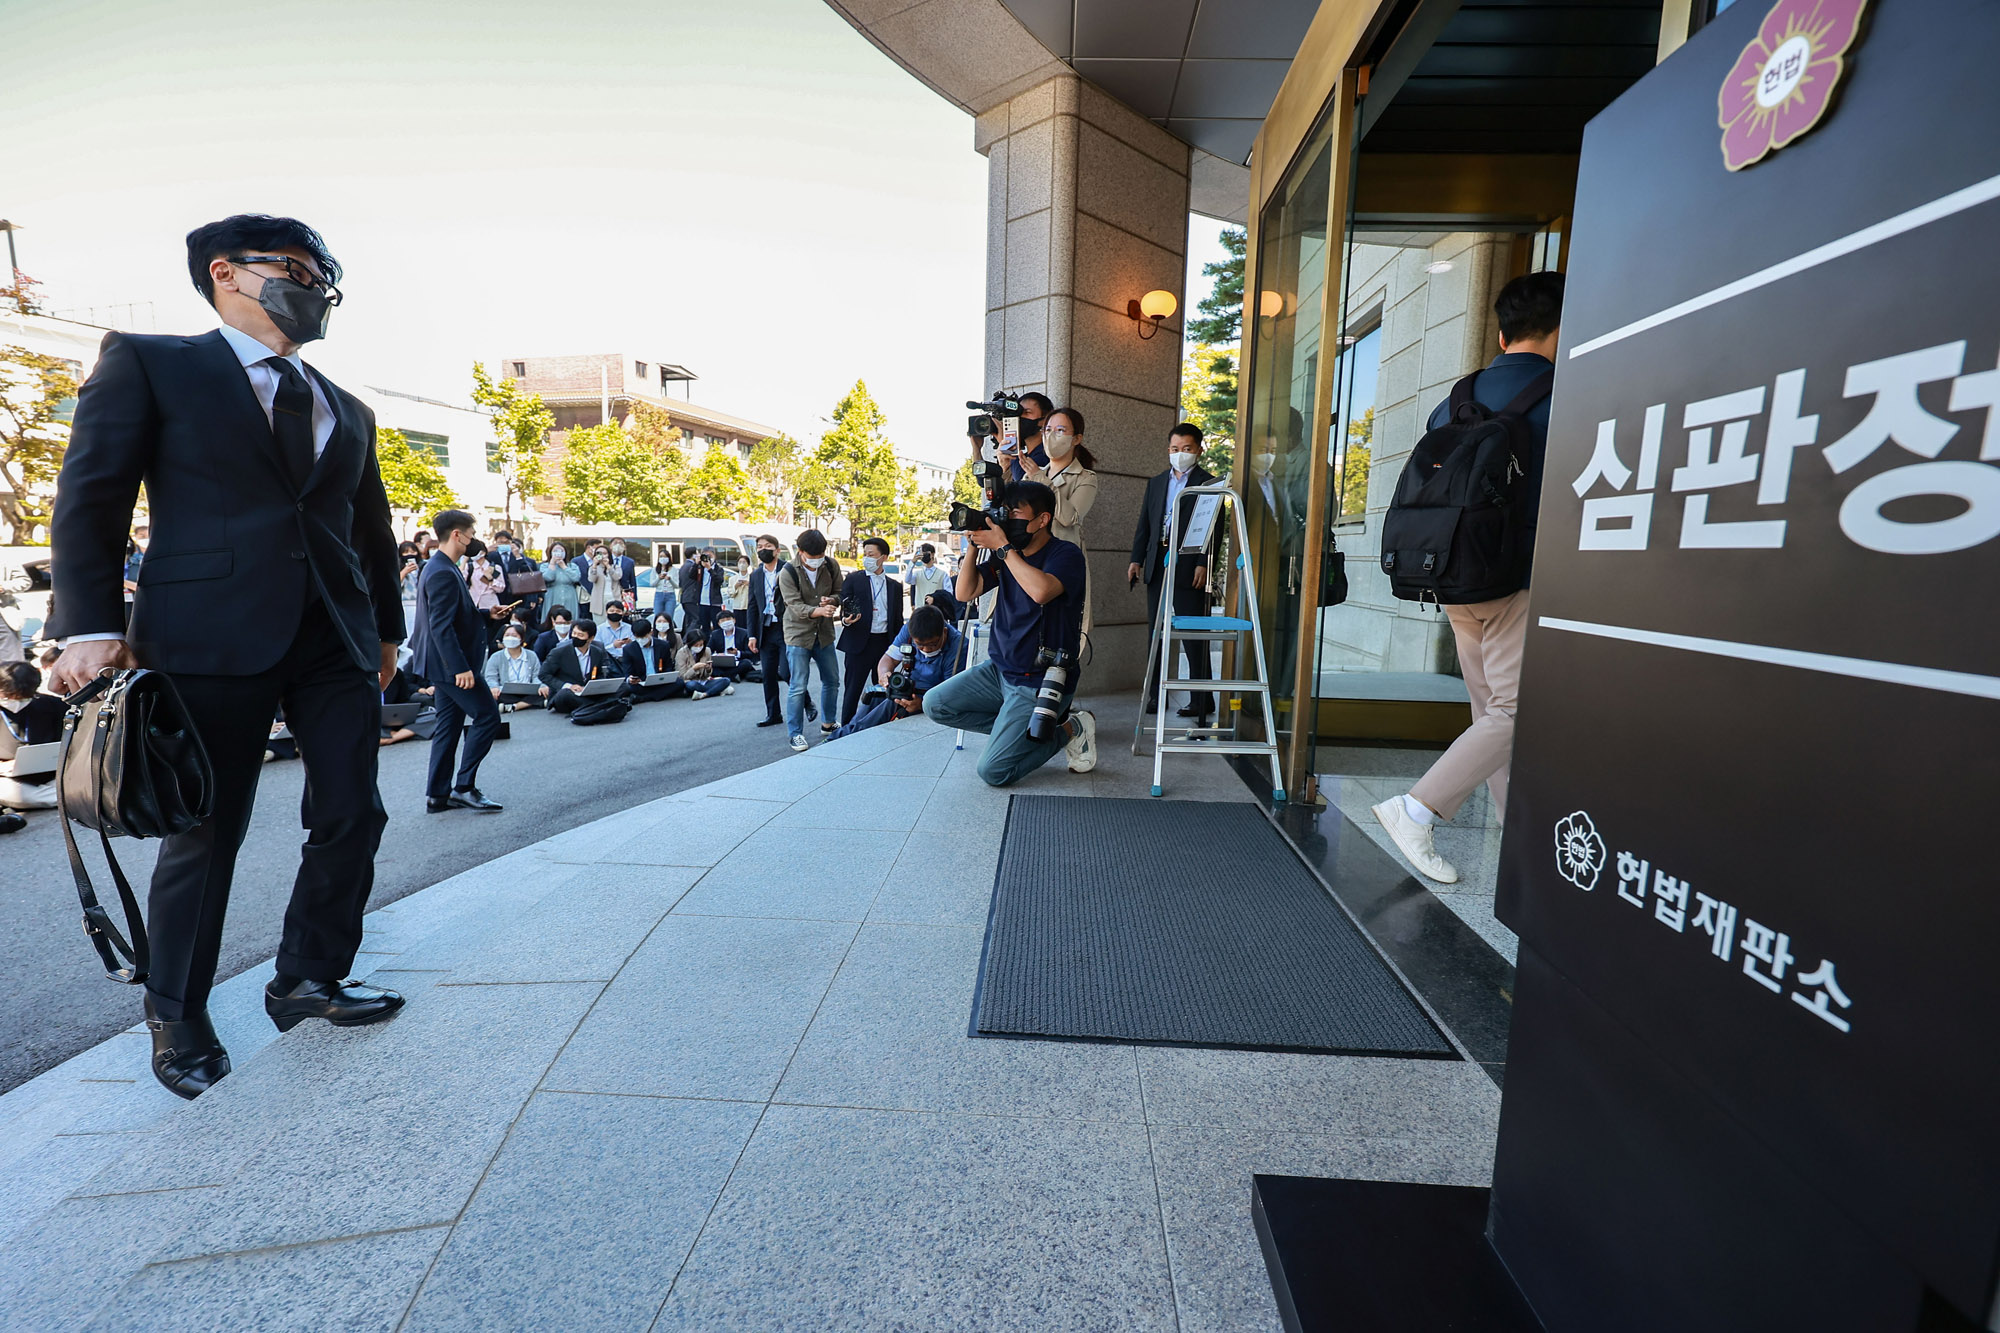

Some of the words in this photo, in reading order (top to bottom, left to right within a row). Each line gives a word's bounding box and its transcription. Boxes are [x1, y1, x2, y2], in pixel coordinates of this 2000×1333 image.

[1765, 47, 1803, 94] 헌법
[1572, 339, 2000, 555] 심판정
[1571, 841, 1585, 859] 헌법
[1616, 850, 1852, 1033] 헌법재판소
